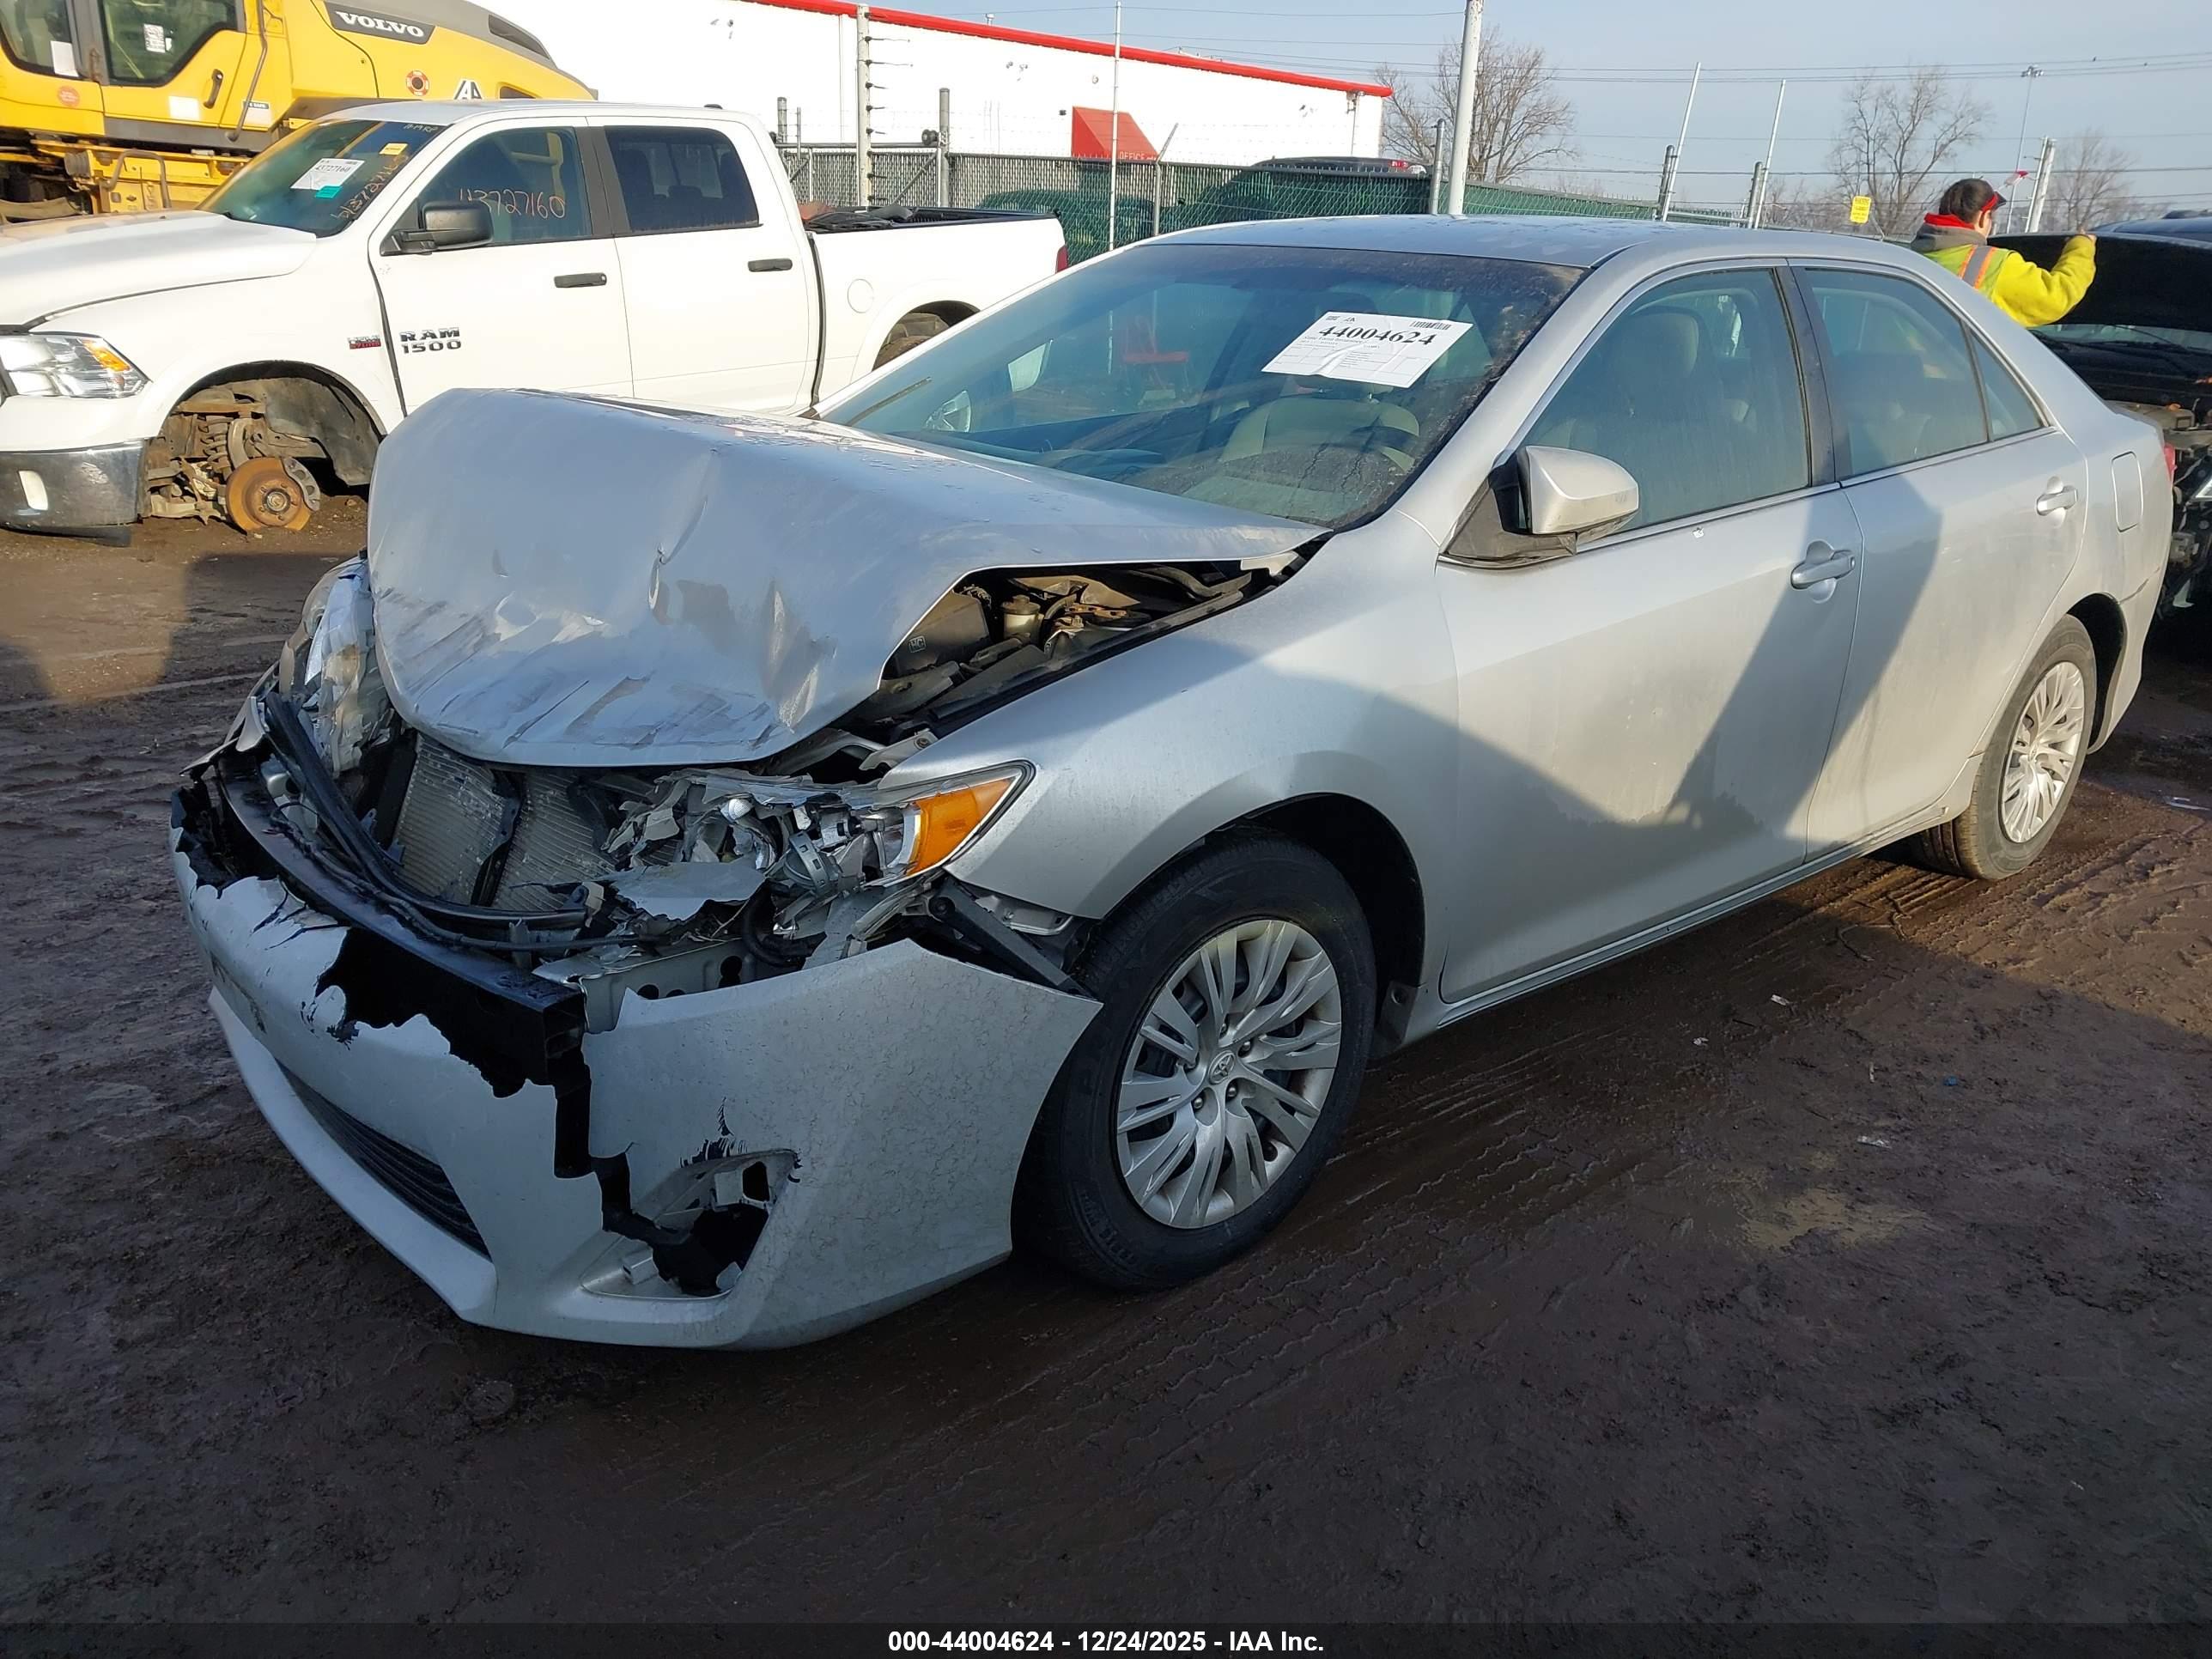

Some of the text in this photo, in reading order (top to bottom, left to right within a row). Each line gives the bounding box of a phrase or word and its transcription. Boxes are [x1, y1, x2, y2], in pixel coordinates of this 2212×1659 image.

[335, 10, 424, 38] VOLVO
[399, 327, 460, 343] RAM
[1318, 325, 1437, 347] 44004624
[401, 340, 462, 354] 1500
